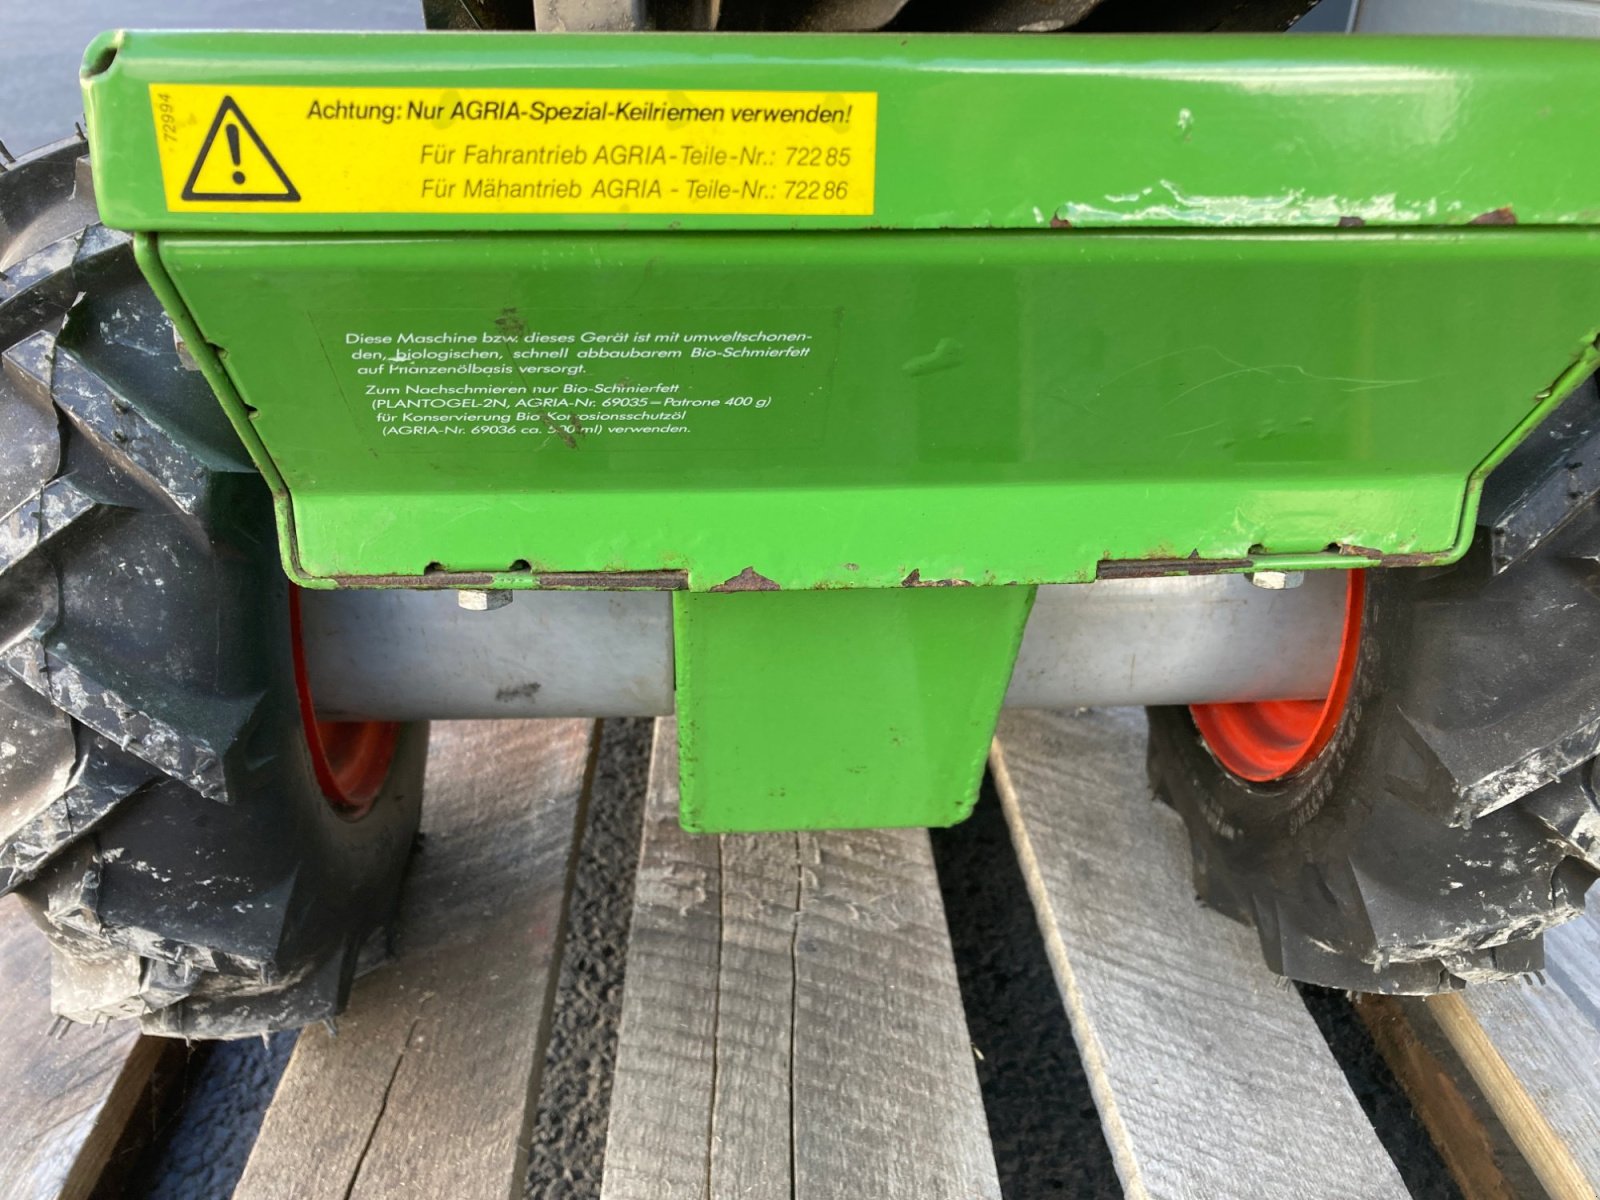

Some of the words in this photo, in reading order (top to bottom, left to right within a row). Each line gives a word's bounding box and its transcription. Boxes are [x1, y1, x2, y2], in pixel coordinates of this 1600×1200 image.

[156, 93, 177, 142] 72994
[307, 100, 402, 125] Achtung:
[407, 101, 444, 120] Nur
[450, 101, 724, 124] AGRIA-Spezial-Keilriemen
[731, 105, 852, 123] verwenden!
[420, 145, 455, 165] Für
[463, 145, 587, 165] Fahrantrieb
[421, 179, 455, 198] Für
[463, 178, 581, 198] Mähantrieb
[345, 333, 392, 344] Diese
[397, 332, 477, 344] Maschine
[482, 332, 518, 344] bzw.
[524, 331, 575, 344] dieses
[580, 331, 629, 343] Gerät
[633, 331, 651, 343] ist
[654, 331, 680, 343] mit
[683, 331, 812, 343] umweltschonen-
[351, 350, 387, 361] den,
[396, 348, 503, 363] biologischen,
[512, 348, 569, 359] schnell
[577, 347, 682, 358] abbaubarem
[690, 347, 811, 358] Bio-Schmierfett
[357, 364, 385, 375] auf
[519, 364, 586, 376] versorgt.
[365, 385, 400, 395] Zum
[405, 384, 527, 395] Nachschmieren
[532, 386, 559, 394] nur
[563, 383, 679, 395] Bio-Schmierfett
[372, 398, 511, 410] (PLANTOGEL-2N,
[515, 397, 596, 408] AGRIA-Nr.
[724, 396, 753, 406] 400
[755, 397, 772, 408] g)
[376, 412, 398, 422] für
[402, 412, 511, 424] Konservierung
[382, 425, 466, 437] (AGRIA-Nr.
[471, 425, 517, 434] 69036
[579, 425, 602, 436] ml)
[608, 424, 691, 434] verwenden.
